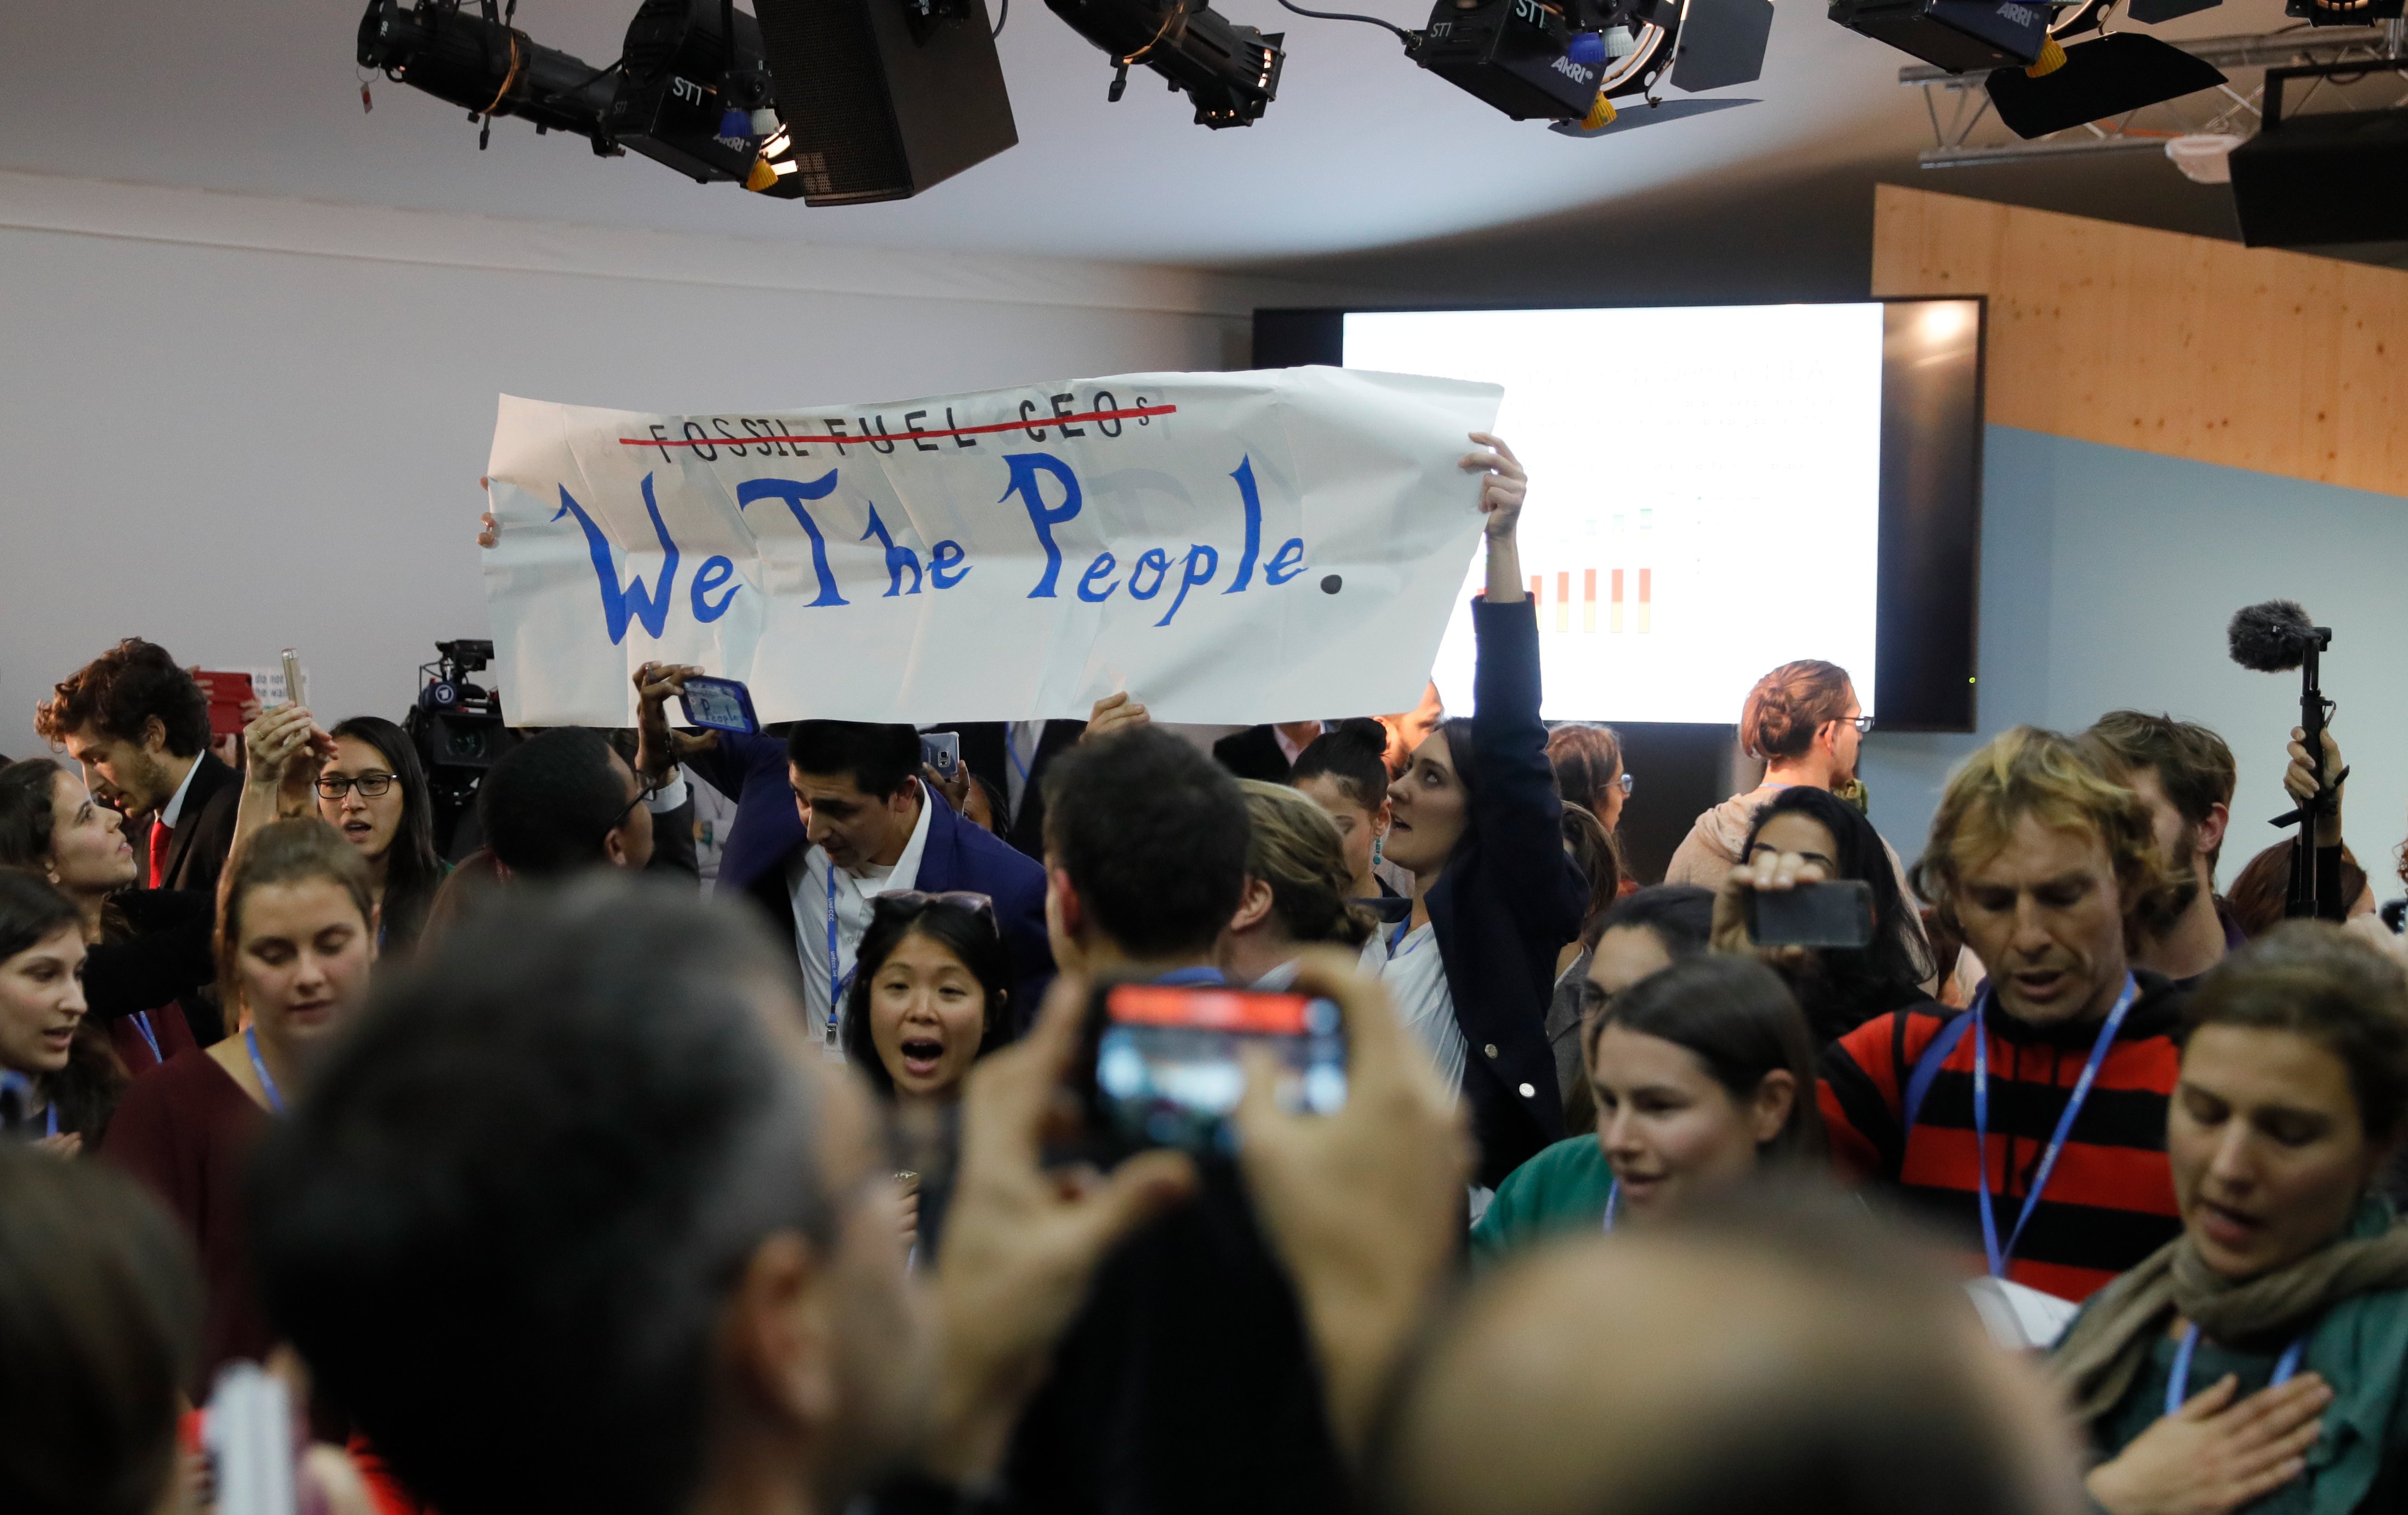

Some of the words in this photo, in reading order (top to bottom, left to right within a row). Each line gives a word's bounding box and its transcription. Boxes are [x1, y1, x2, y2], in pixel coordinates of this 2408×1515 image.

[1996, 2, 2032, 27] ARRI
[648, 418, 809, 463] FOSSIL
[823, 406, 978, 455] FUEL
[551, 470, 743, 646] We
[737, 468, 974, 608] The
[996, 452, 1343, 628] People.
[830, 950, 838, 977] unfccc.int
